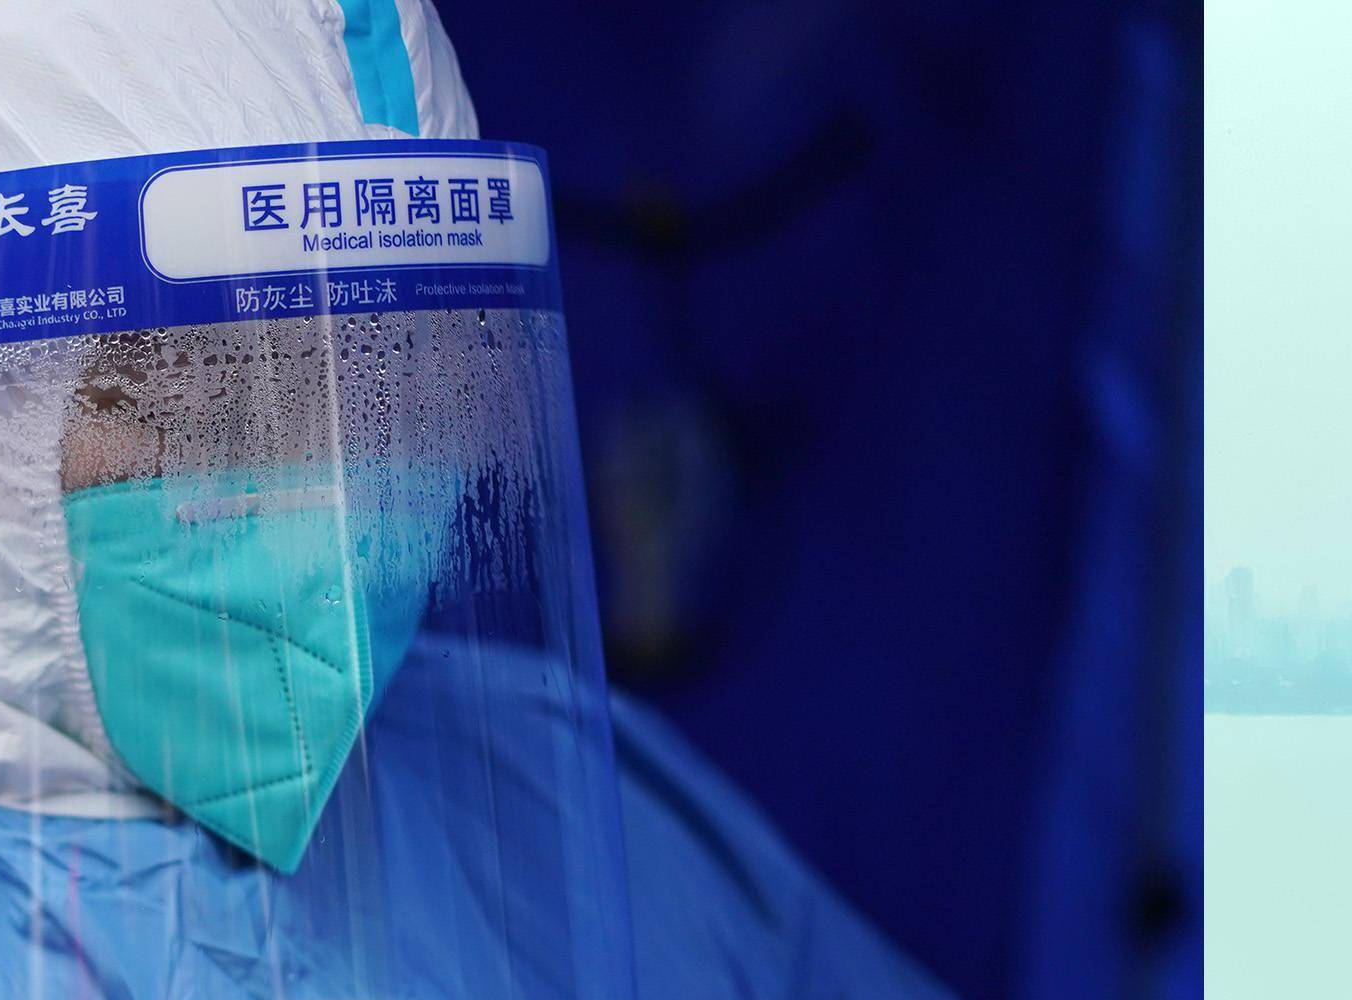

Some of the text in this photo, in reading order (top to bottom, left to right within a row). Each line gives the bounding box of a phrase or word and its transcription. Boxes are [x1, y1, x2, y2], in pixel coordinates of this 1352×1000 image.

[241, 176, 515, 232] 医用隔离面罩
[302, 229, 484, 252] Medical isolation mask
[235, 278, 398, 313] 防灰尘 防吐沫
[415, 282, 466, 297] Protective
[37, 311, 81, 328] Industry
